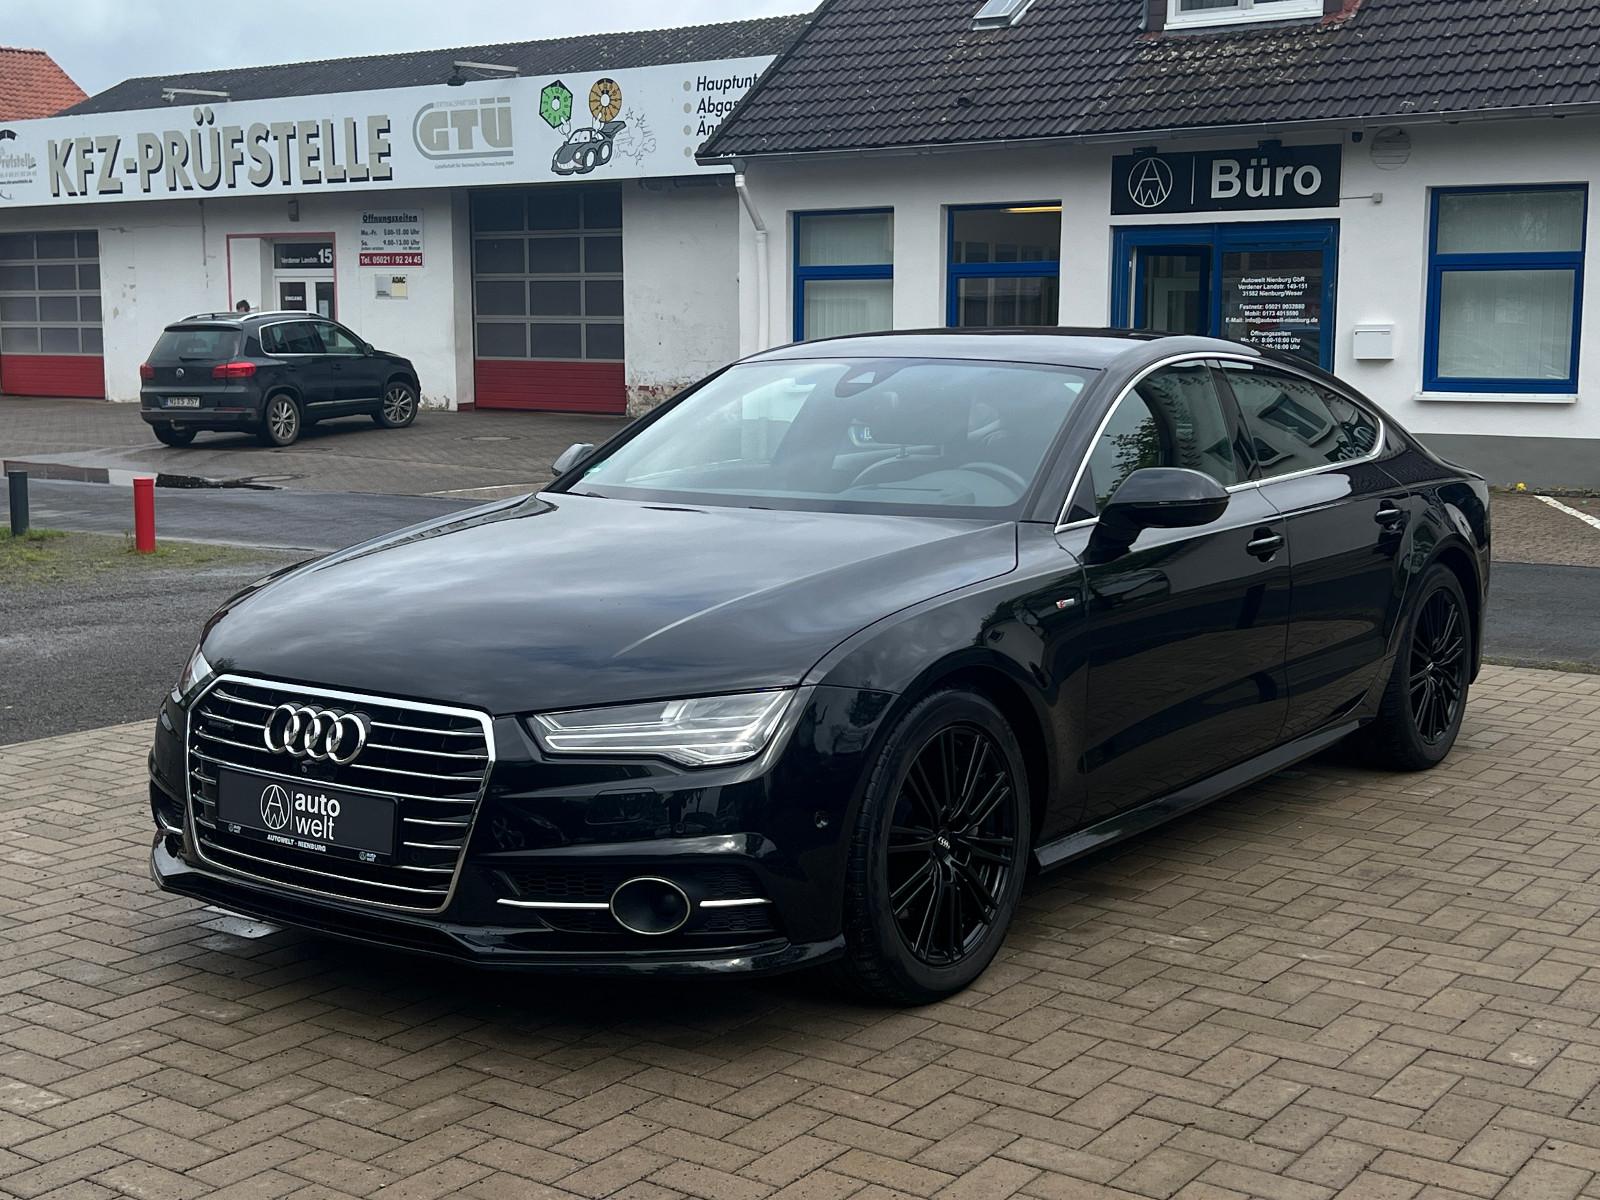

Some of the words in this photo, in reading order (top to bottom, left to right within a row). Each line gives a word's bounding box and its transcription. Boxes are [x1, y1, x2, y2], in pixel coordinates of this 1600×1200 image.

[418, 97, 513, 152] GTÜ
[47, 106, 393, 197] KFZ-PRÜFSTELLE
[0, 152, 36, 170] rüfstelle
[1211, 158, 1322, 198] Büro
[362, 212, 418, 223] Öffnungszeiten
[318, 248, 333, 264] 15
[360, 256, 372, 264] Tel.
[373, 256, 390, 264] 05021
[395, 256, 404, 264] 92
[404, 256, 412, 264] 24
[413, 256, 421, 264] 45
[391, 276, 406, 284] ADAC
[295, 793, 340, 817] auto
[295, 816, 334, 840] welt
[267, 834, 294, 845] AUTOWELT
[298, 841, 326, 852] NIENBURG
